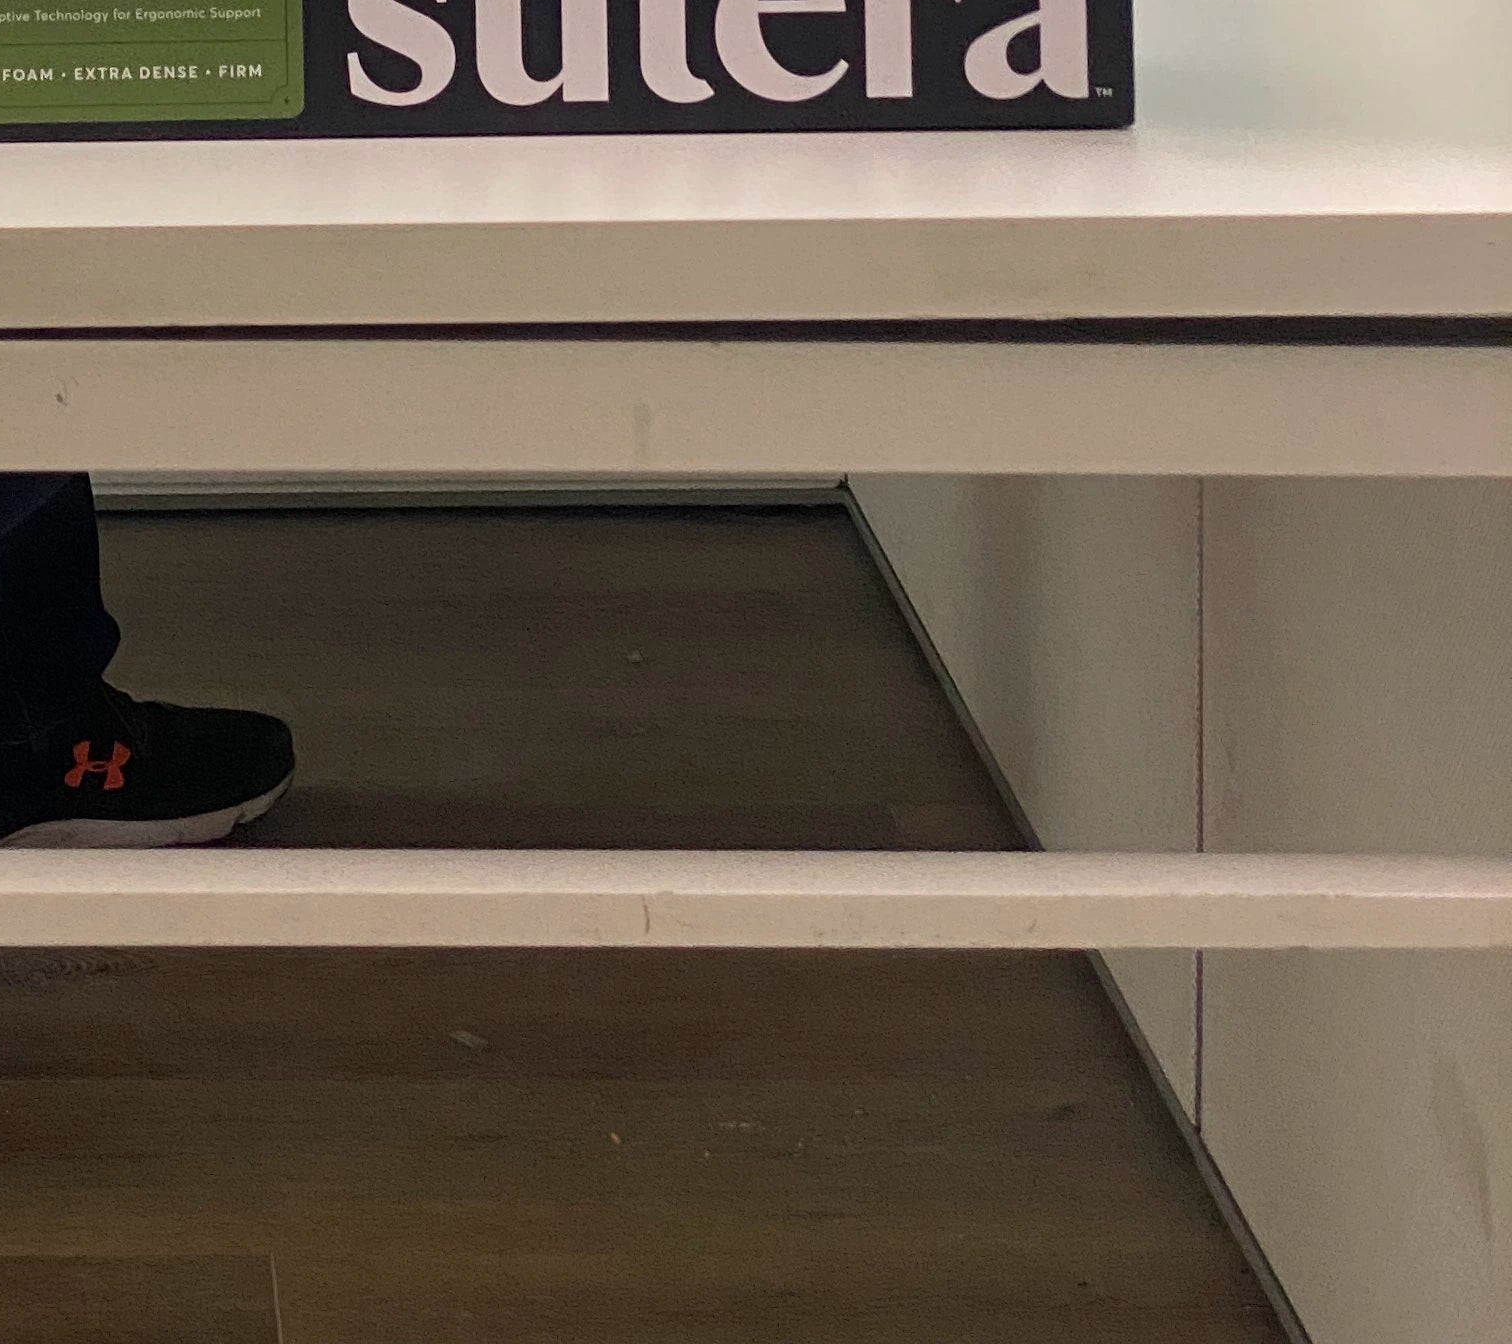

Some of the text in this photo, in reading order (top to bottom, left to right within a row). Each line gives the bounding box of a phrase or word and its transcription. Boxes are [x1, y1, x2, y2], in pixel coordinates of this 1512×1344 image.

[34, 9, 109, 24] Technology
[113, 7, 131, 20] for
[135, 7, 206, 23] Ergonomic
[209, 6, 262, 21] Support
[2, 67, 54, 82] FOAM
[74, 66, 133, 81] EXTRA
[139, 65, 199, 80] DENSE
[218, 63, 263, 79] FIRM
